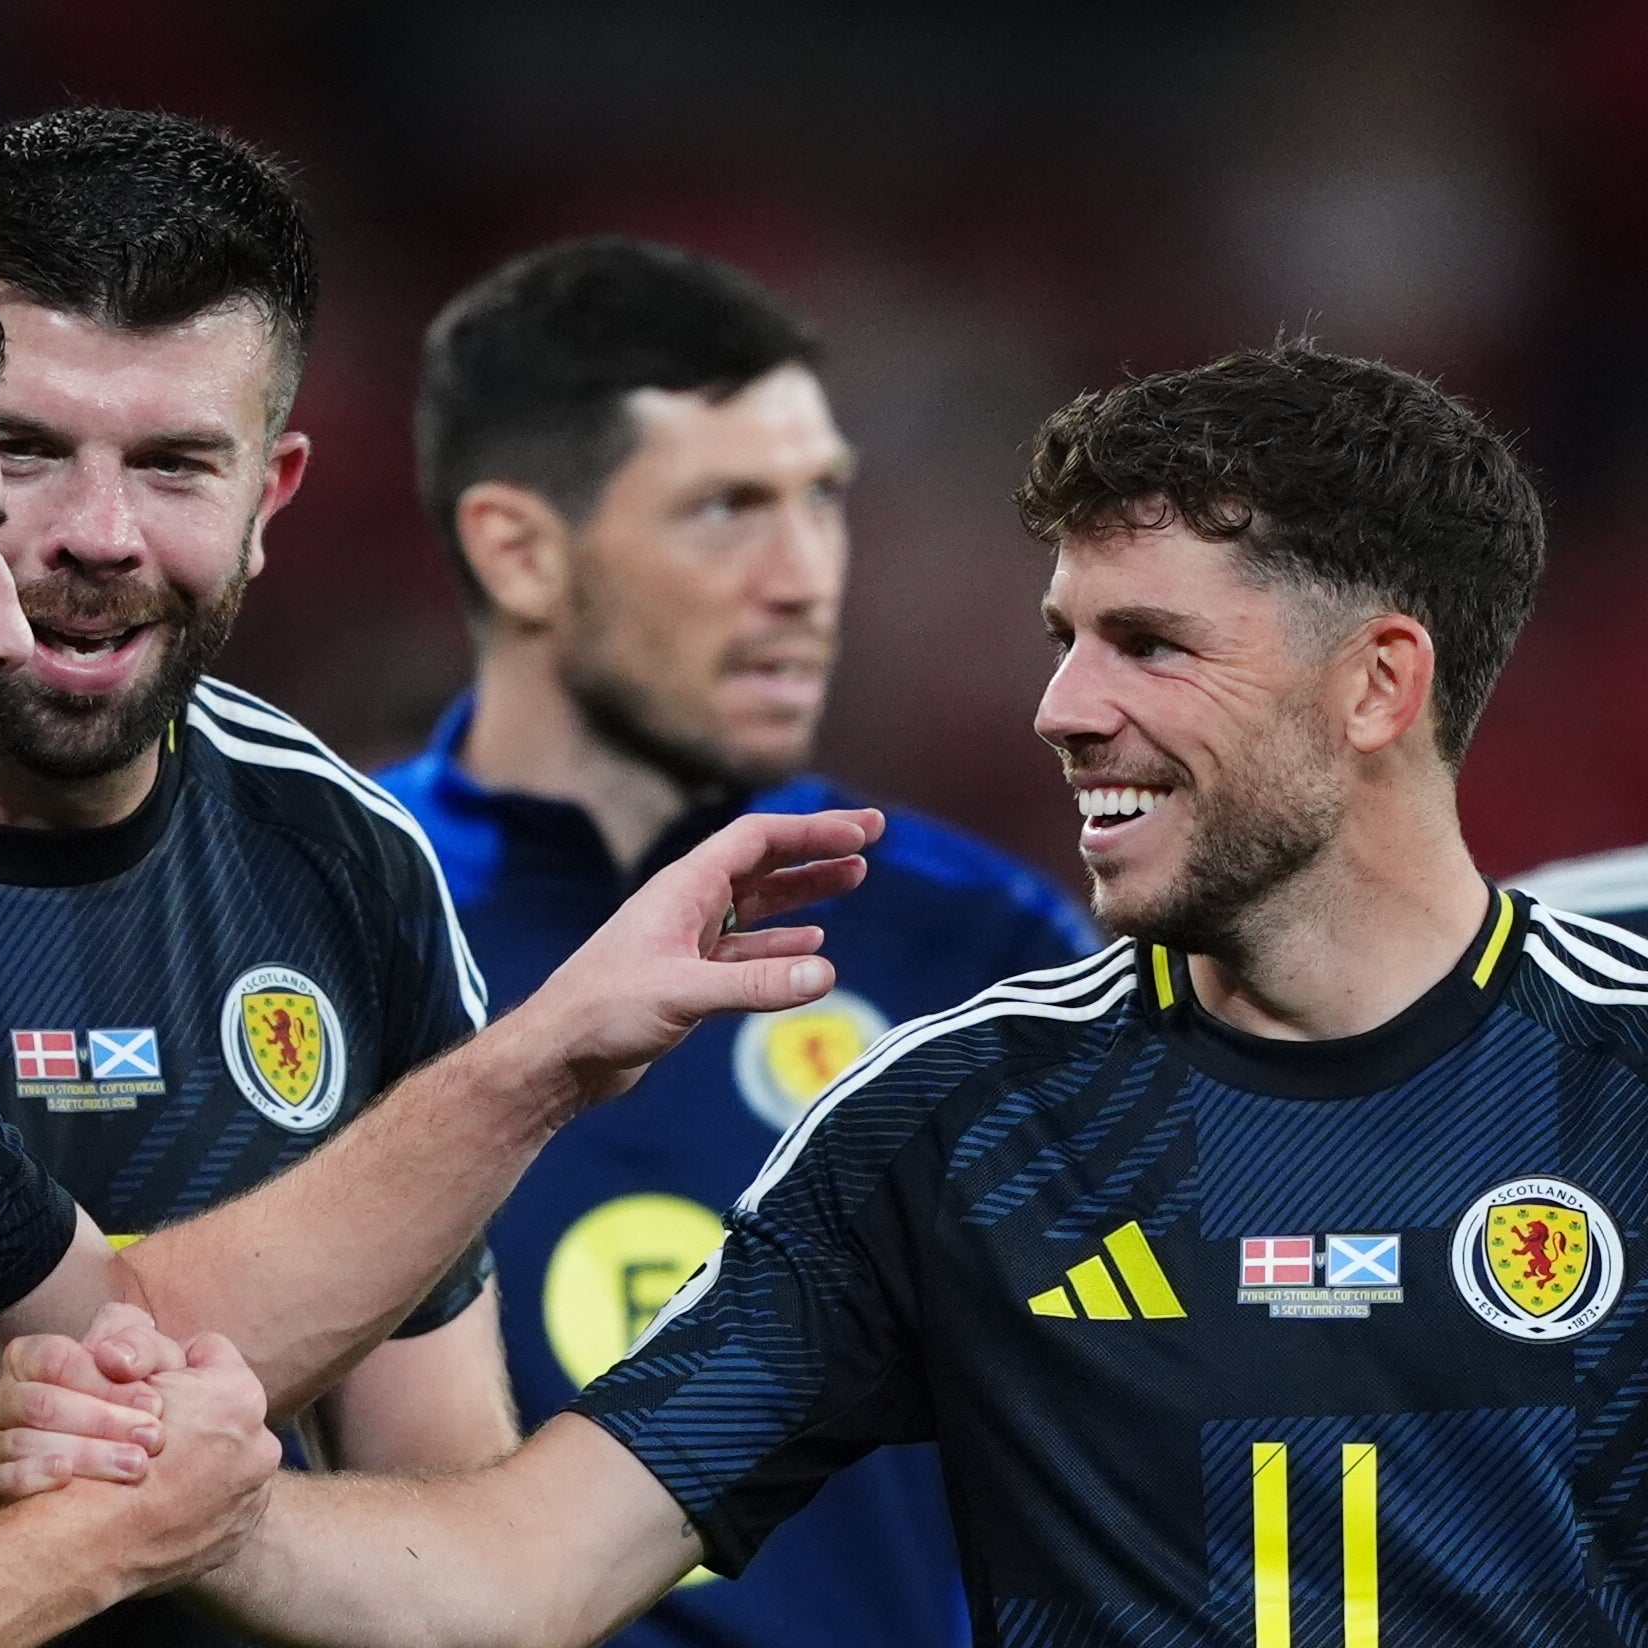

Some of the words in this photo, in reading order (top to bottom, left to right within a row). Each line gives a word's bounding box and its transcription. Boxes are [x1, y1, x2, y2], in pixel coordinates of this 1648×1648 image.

[245, 973, 307, 991] SCOTLAND
[251, 1093, 270, 1111] EST
[1498, 1184, 1577, 1206] SCOTLAND
[1478, 1302, 1501, 1321] EST
[1572, 1308, 1598, 1330] 1873
